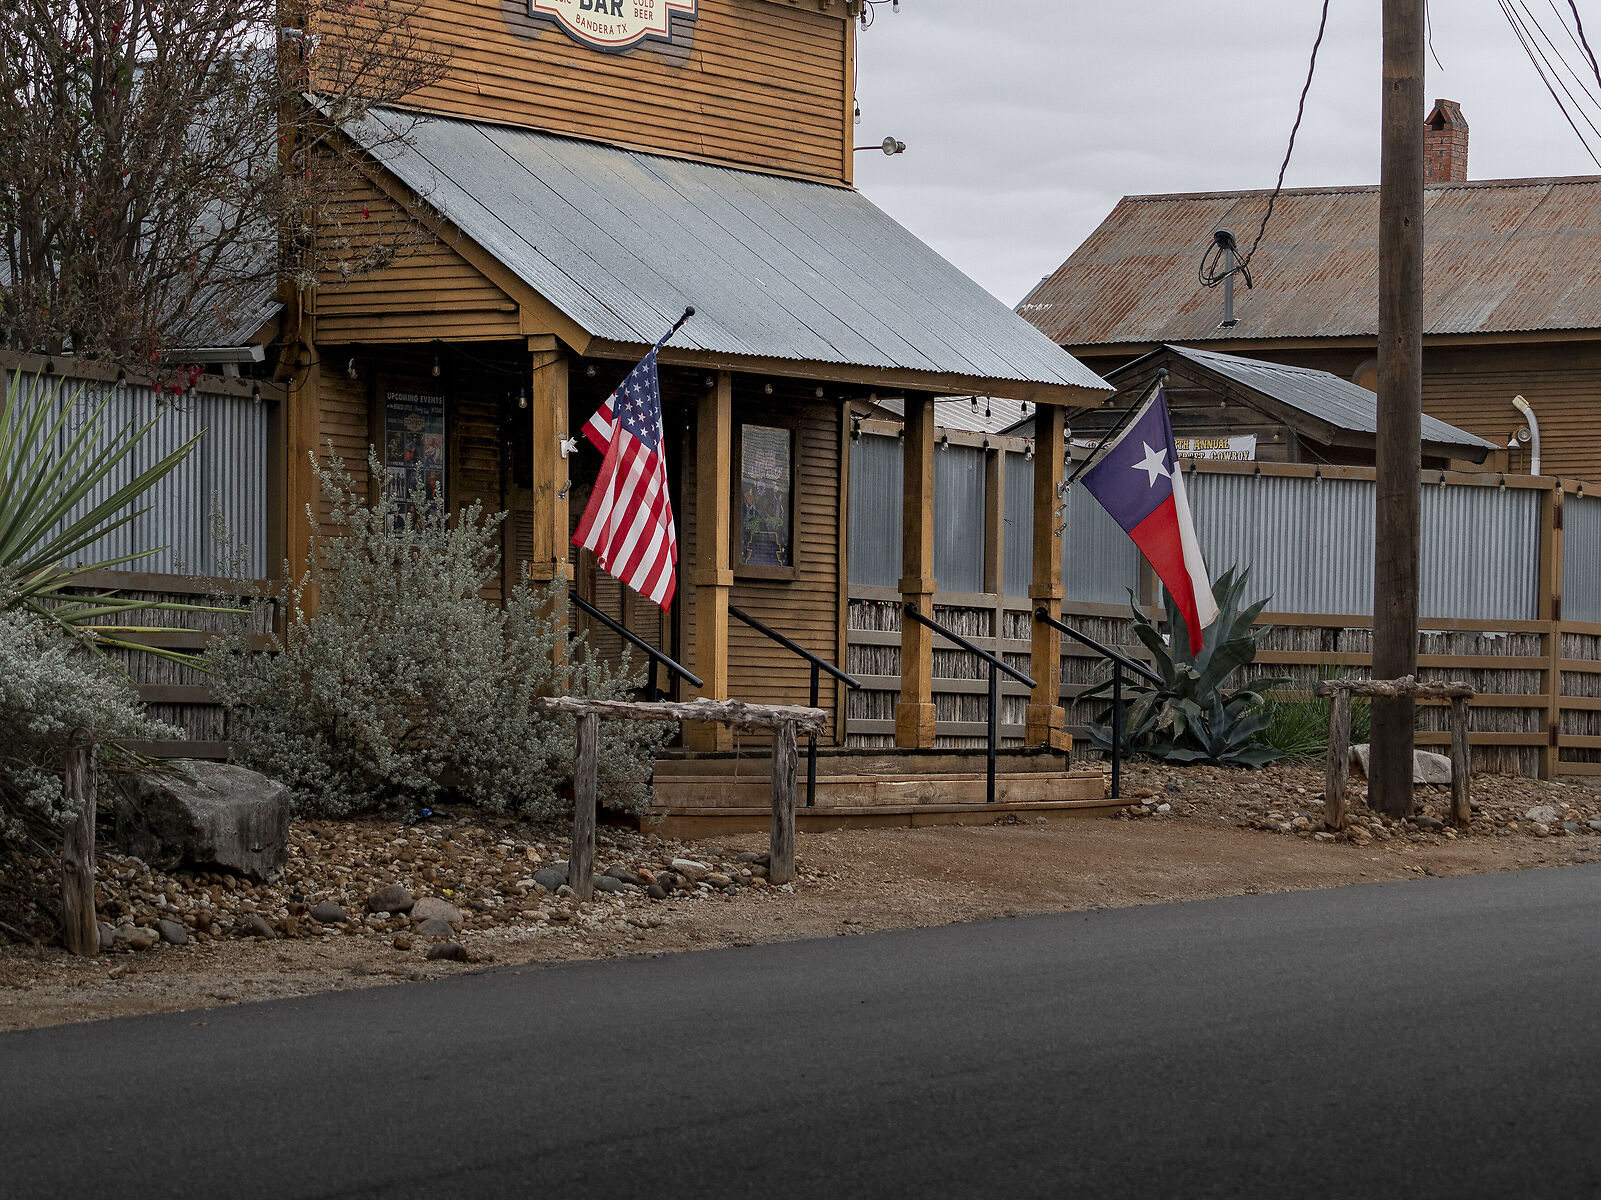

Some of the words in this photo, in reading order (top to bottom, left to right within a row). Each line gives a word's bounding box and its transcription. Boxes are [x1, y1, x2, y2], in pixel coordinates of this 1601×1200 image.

[634, 8, 654, 21] BEER
[575, 13, 615, 35] BANDERA
[616, 23, 628, 35] TX
[386, 391, 419, 403] UPCOMING
[420, 395, 443, 405] EVENTS
[1193, 439, 1230, 450] ANNUAL
[1210, 450, 1250, 460] COWBOY
